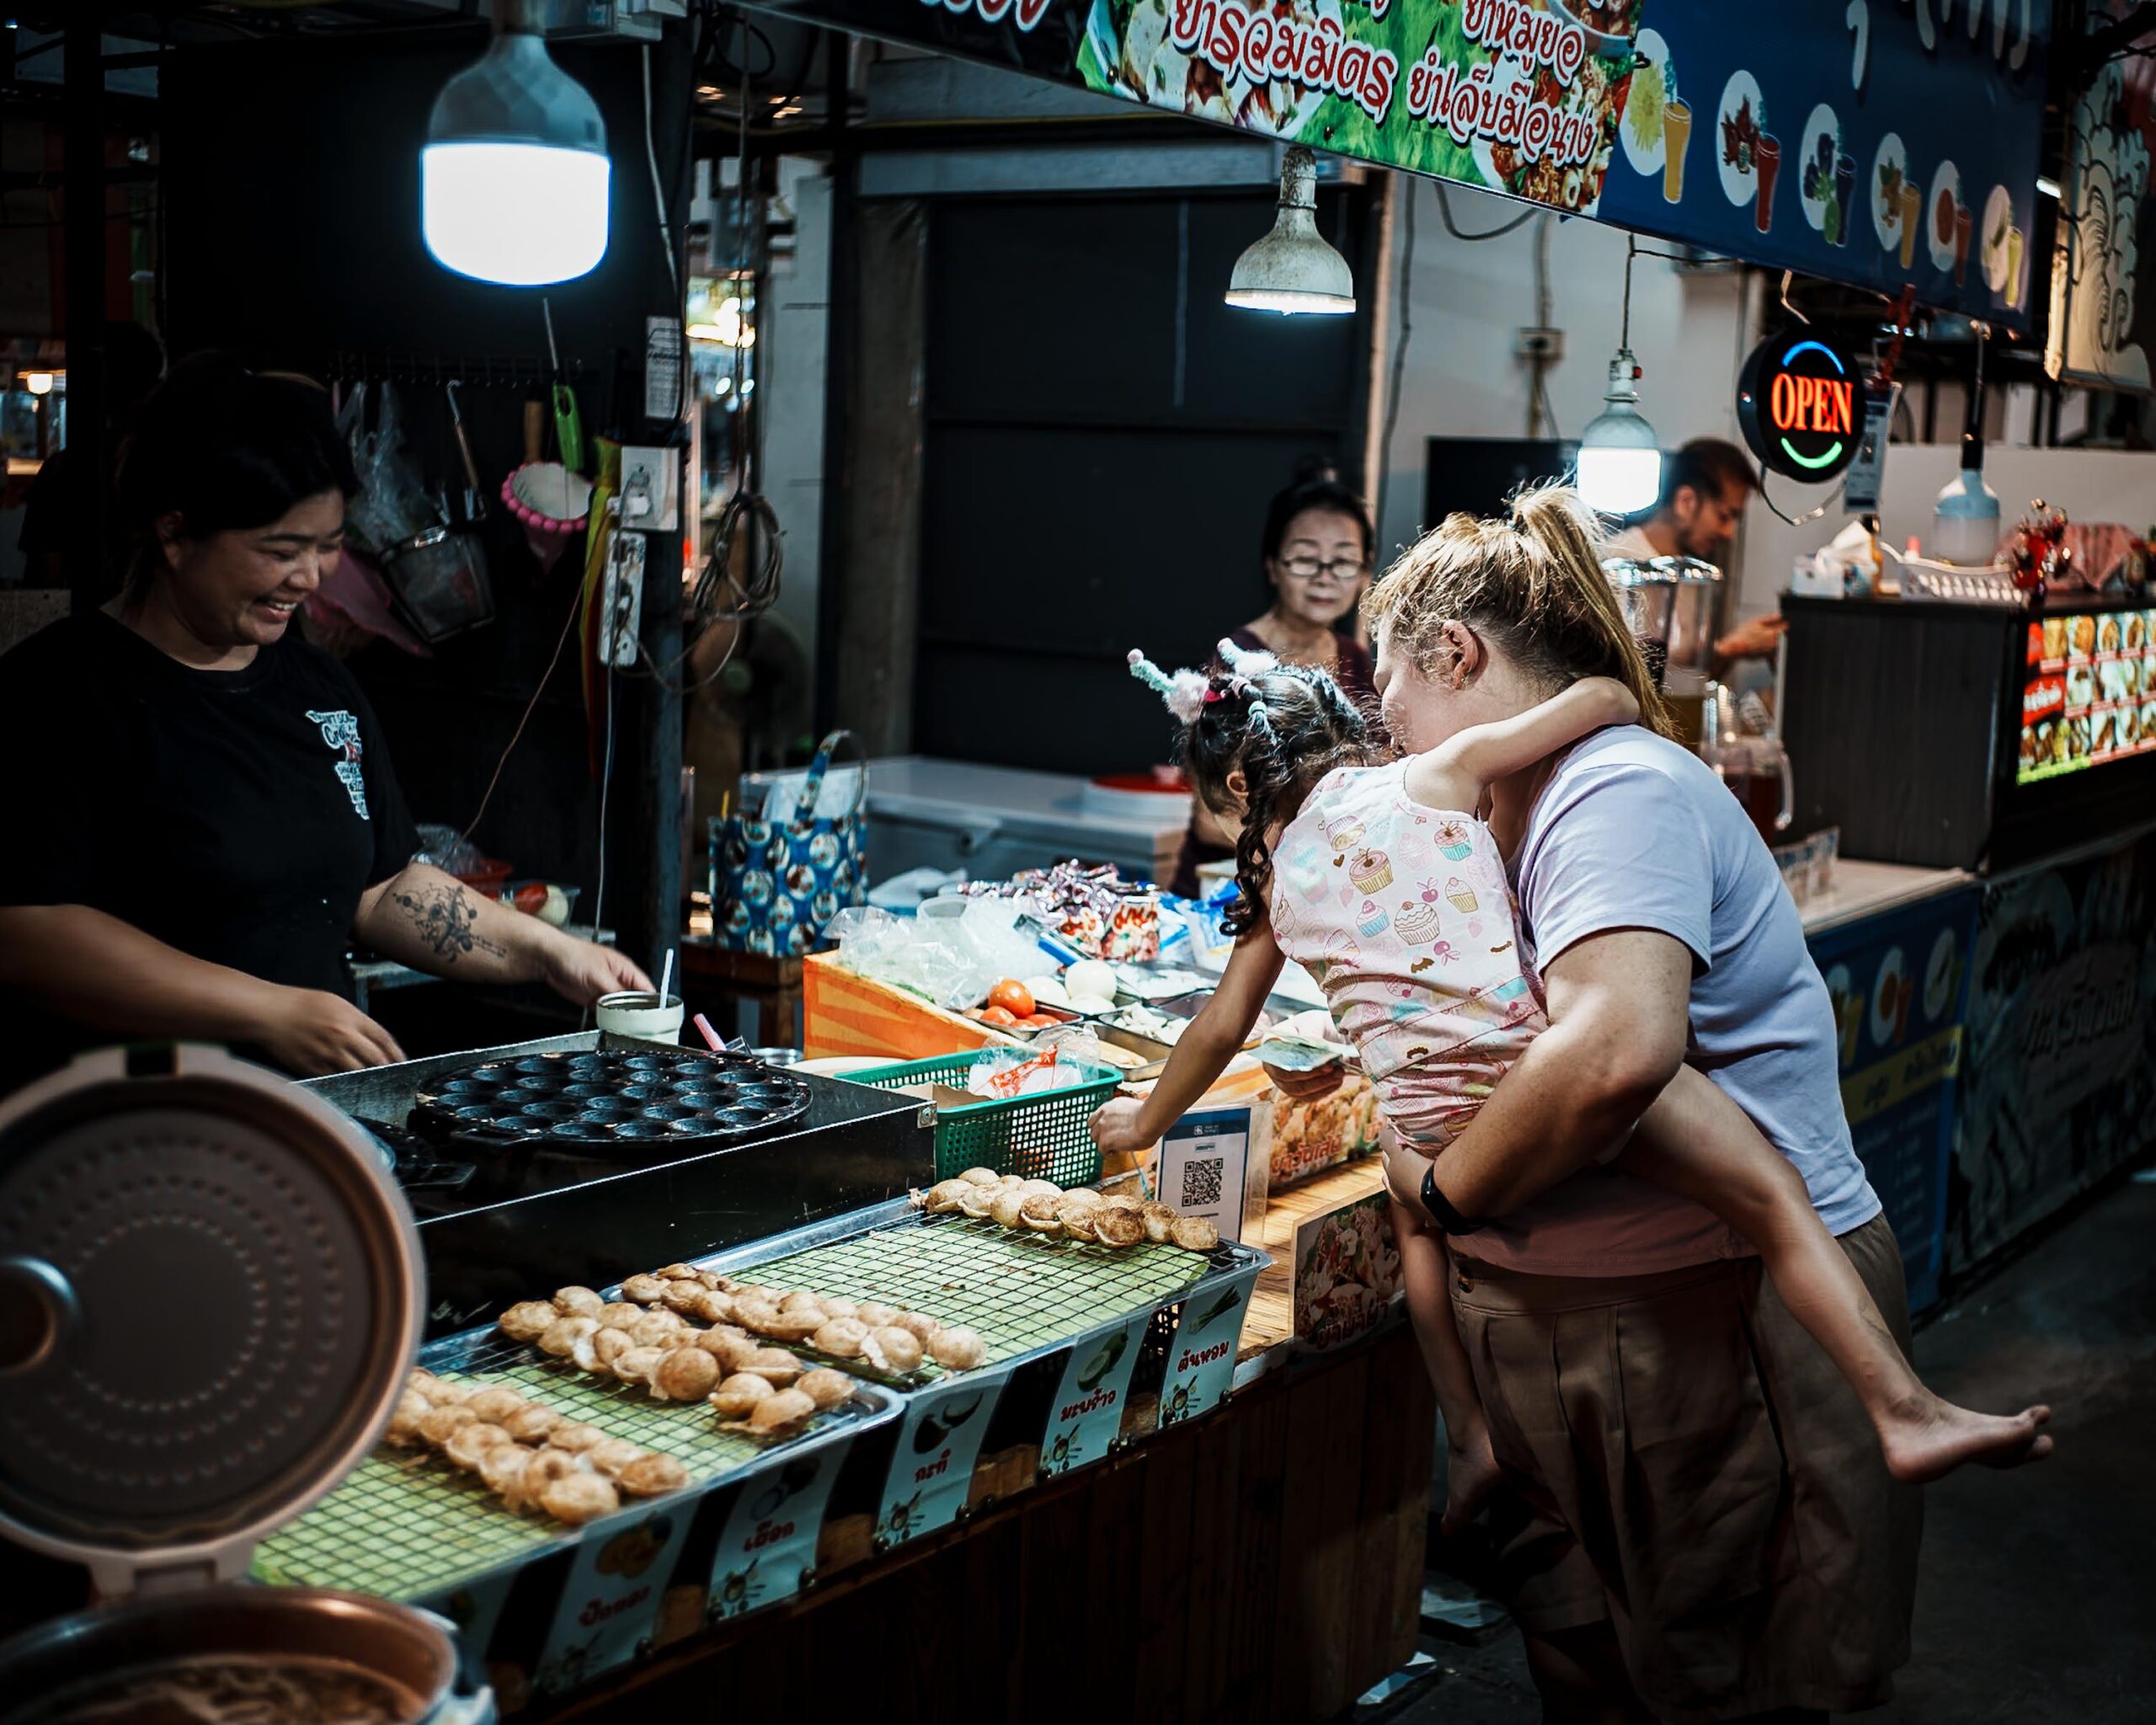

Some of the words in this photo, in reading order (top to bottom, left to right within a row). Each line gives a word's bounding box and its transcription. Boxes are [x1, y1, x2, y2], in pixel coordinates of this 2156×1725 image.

[1409, 51, 1596, 163] ยำเล็บมือนาง
[1771, 373, 1853, 435] OPEN
[1178, 1340, 1229, 1372] ต้นหอม
[1061, 1387, 1116, 1422] มะพร้าว
[915, 1448, 951, 1483] กะทิ
